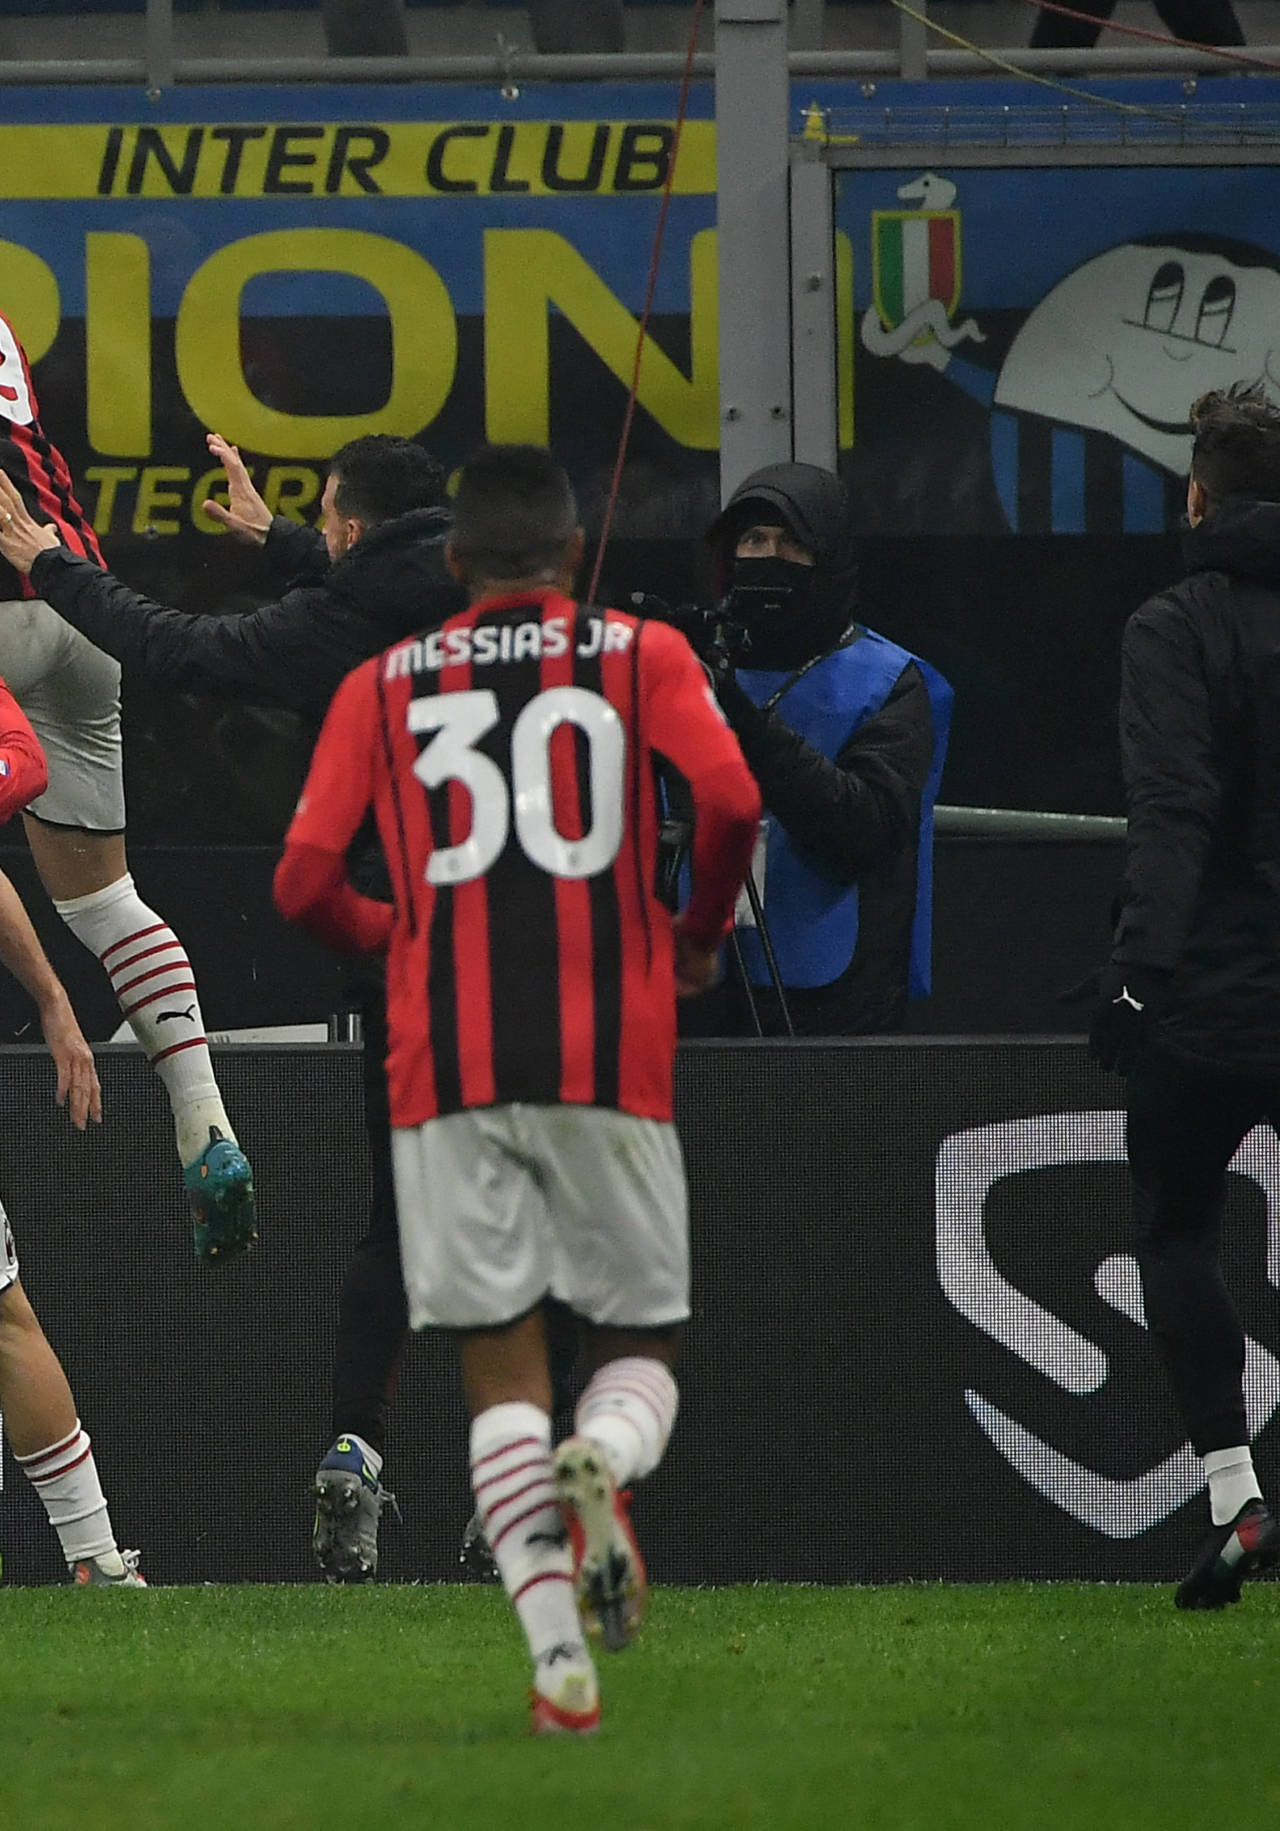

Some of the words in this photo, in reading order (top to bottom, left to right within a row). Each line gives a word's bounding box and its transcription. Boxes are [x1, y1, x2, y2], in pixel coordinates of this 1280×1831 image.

[97, 126, 391, 196] INTER
[425, 124, 676, 193] CLUB
[385, 618, 568, 681] MESSIAS
[576, 618, 635, 658] JR
[406, 685, 627, 886] 30
